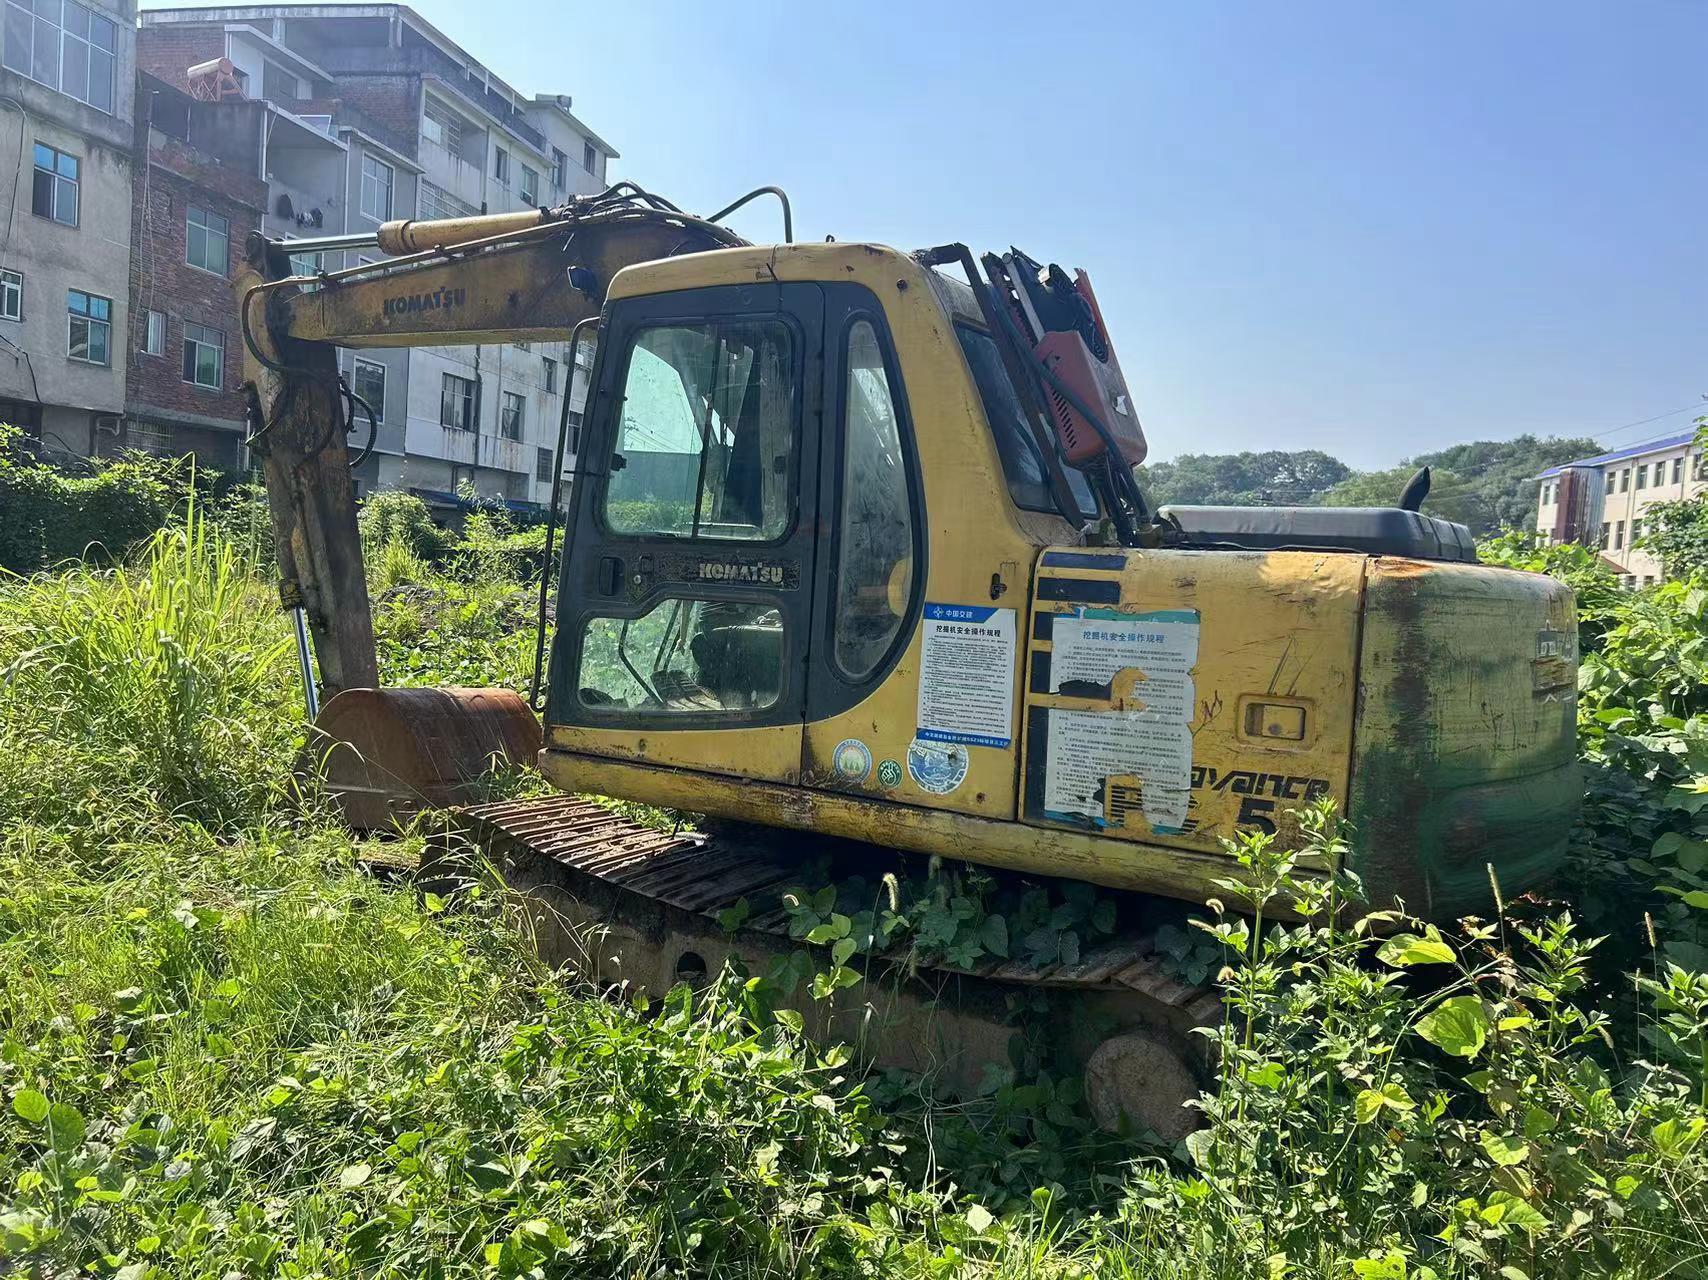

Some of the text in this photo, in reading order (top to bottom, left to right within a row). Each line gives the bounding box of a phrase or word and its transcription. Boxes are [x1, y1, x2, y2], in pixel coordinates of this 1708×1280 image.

[383, 286, 466, 316] KOMATSU
[699, 562, 783, 582] KOMATSU
[935, 625, 1001, 637] 挖掘机安全操作规程
[1083, 630, 1165, 644] 挖掘机安全操作规程
